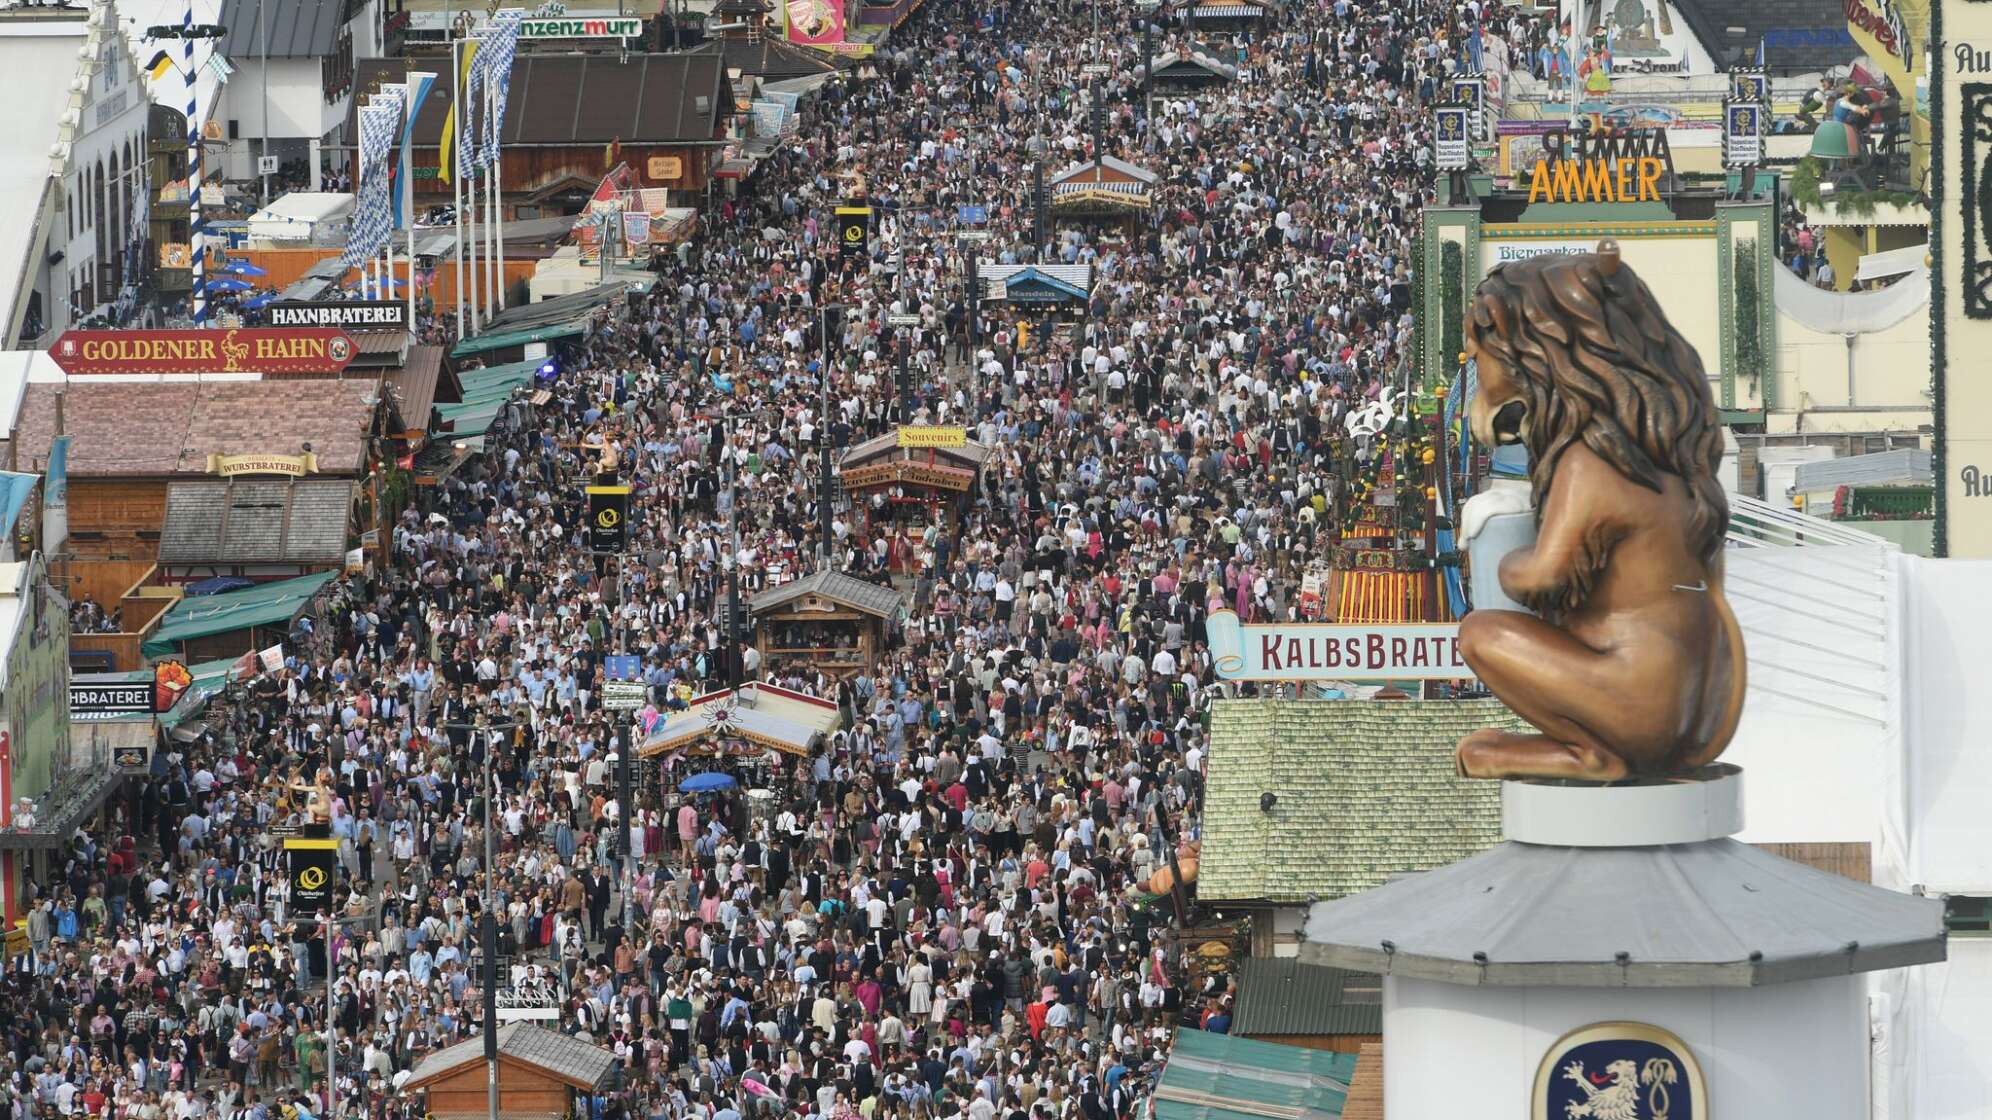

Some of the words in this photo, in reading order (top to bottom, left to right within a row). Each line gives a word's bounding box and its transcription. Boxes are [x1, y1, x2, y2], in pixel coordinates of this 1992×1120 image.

[520, 19, 638, 36] nzenzmurr
[1528, 157, 1663, 203] AMMER
[272, 307, 402, 325] HAXNBRATEREI
[82, 339, 216, 361] GOLDENER
[256, 338, 325, 359] HAHN
[905, 432, 958, 441] Souvenirs
[223, 462, 301, 473] WURSTBRATEREI
[1262, 633, 1465, 670] KALBSBRATE
[69, 691, 150, 704] HBRATEREI
